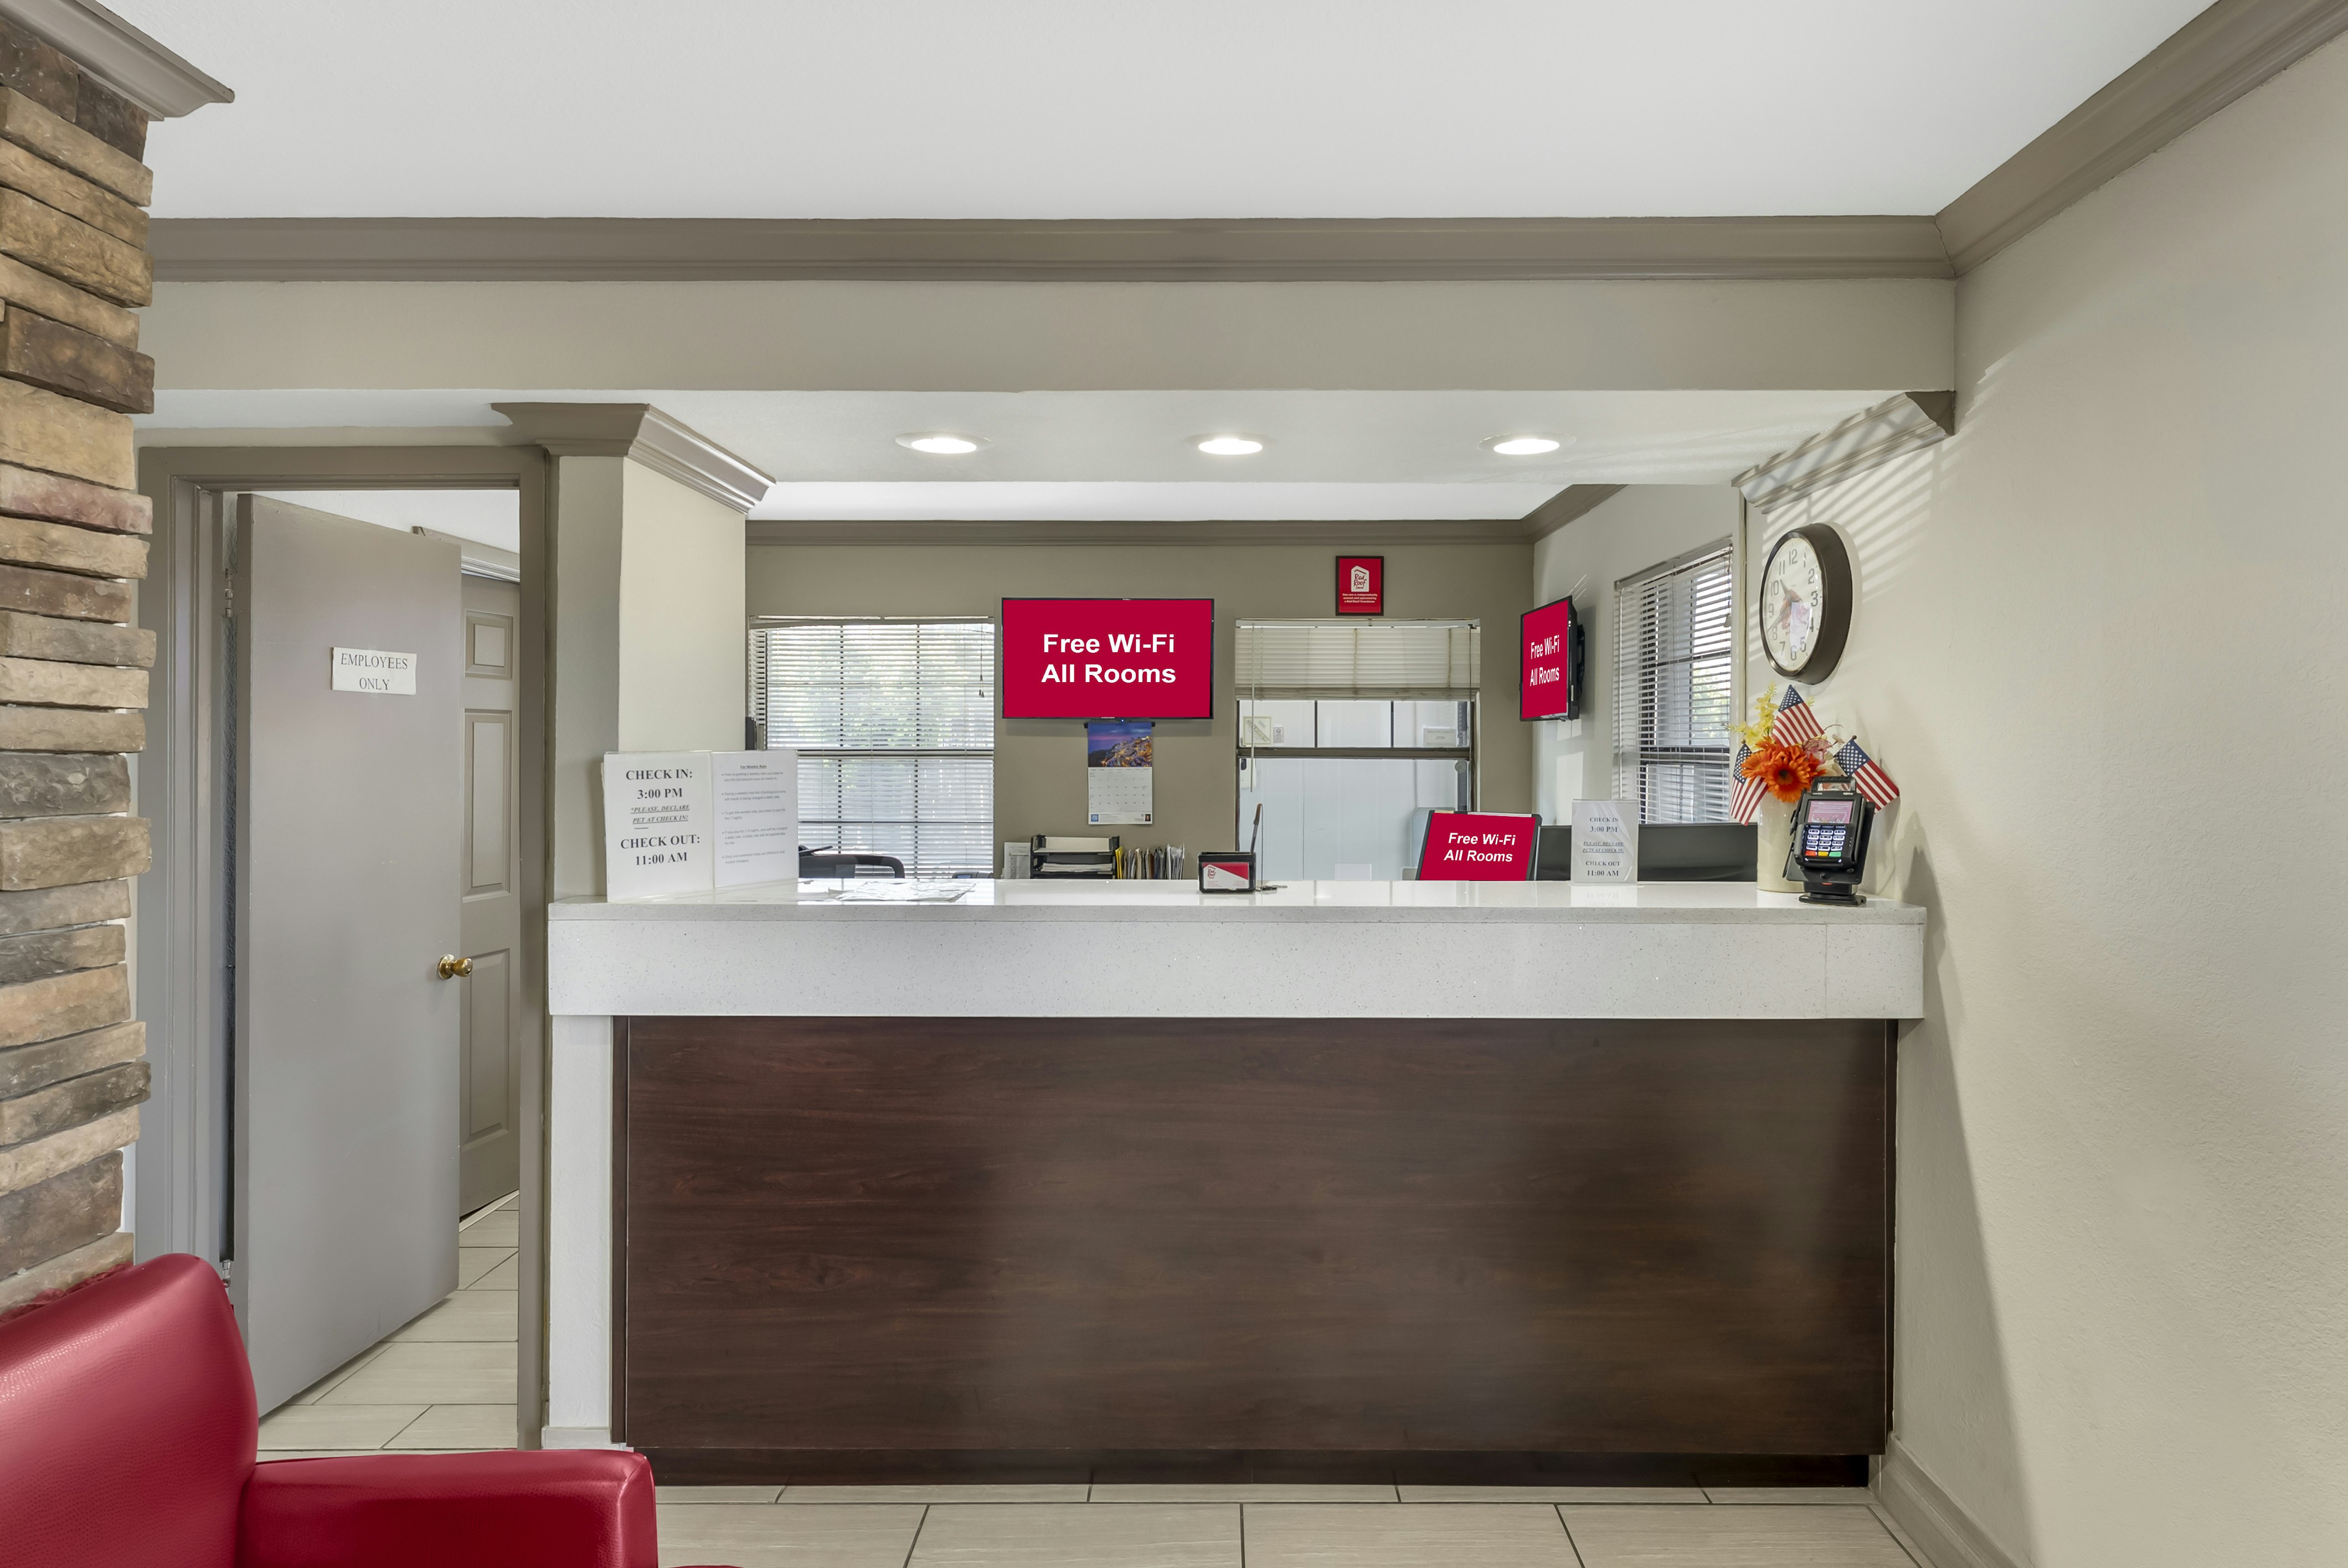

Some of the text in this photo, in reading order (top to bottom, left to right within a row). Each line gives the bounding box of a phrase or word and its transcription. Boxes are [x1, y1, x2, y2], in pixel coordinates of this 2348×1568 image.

[1789, 549, 1798, 565] 12
[1803, 553, 1807, 568] 1
[1779, 560, 1785, 576] 11
[1354, 579, 1367, 587] Roof
[1808, 568, 1815, 585] 2
[1770, 580, 1779, 596] 10
[1811, 590, 1819, 607] 3
[1768, 603, 1774, 618] 9
[1807, 617, 1815, 632] 4
[1772, 626, 1778, 641] 8
[1043, 633, 1175, 653] Free Wi-Fi
[1531, 634, 1560, 659] Free Wi-Fi
[1779, 641, 1786, 656] 7
[1800, 636, 1806, 652] 5
[1790, 645, 1797, 661] 6
[341, 652, 408, 670] EMPLOYEES
[1041, 663, 1177, 683] All Rooms
[1539, 666, 1560, 684] Rooms
[359, 677, 390, 690] ONLY
[626, 768, 693, 780] CHECK IN:
[637, 787, 683, 800] 3:00 PM
[620, 834, 700, 849] CHECK OUT:
[1448, 832, 1516, 845] Free Wi-Fi
[636, 852, 688, 865] 11:00 AM
[1443, 849, 1513, 862] All Rooms
